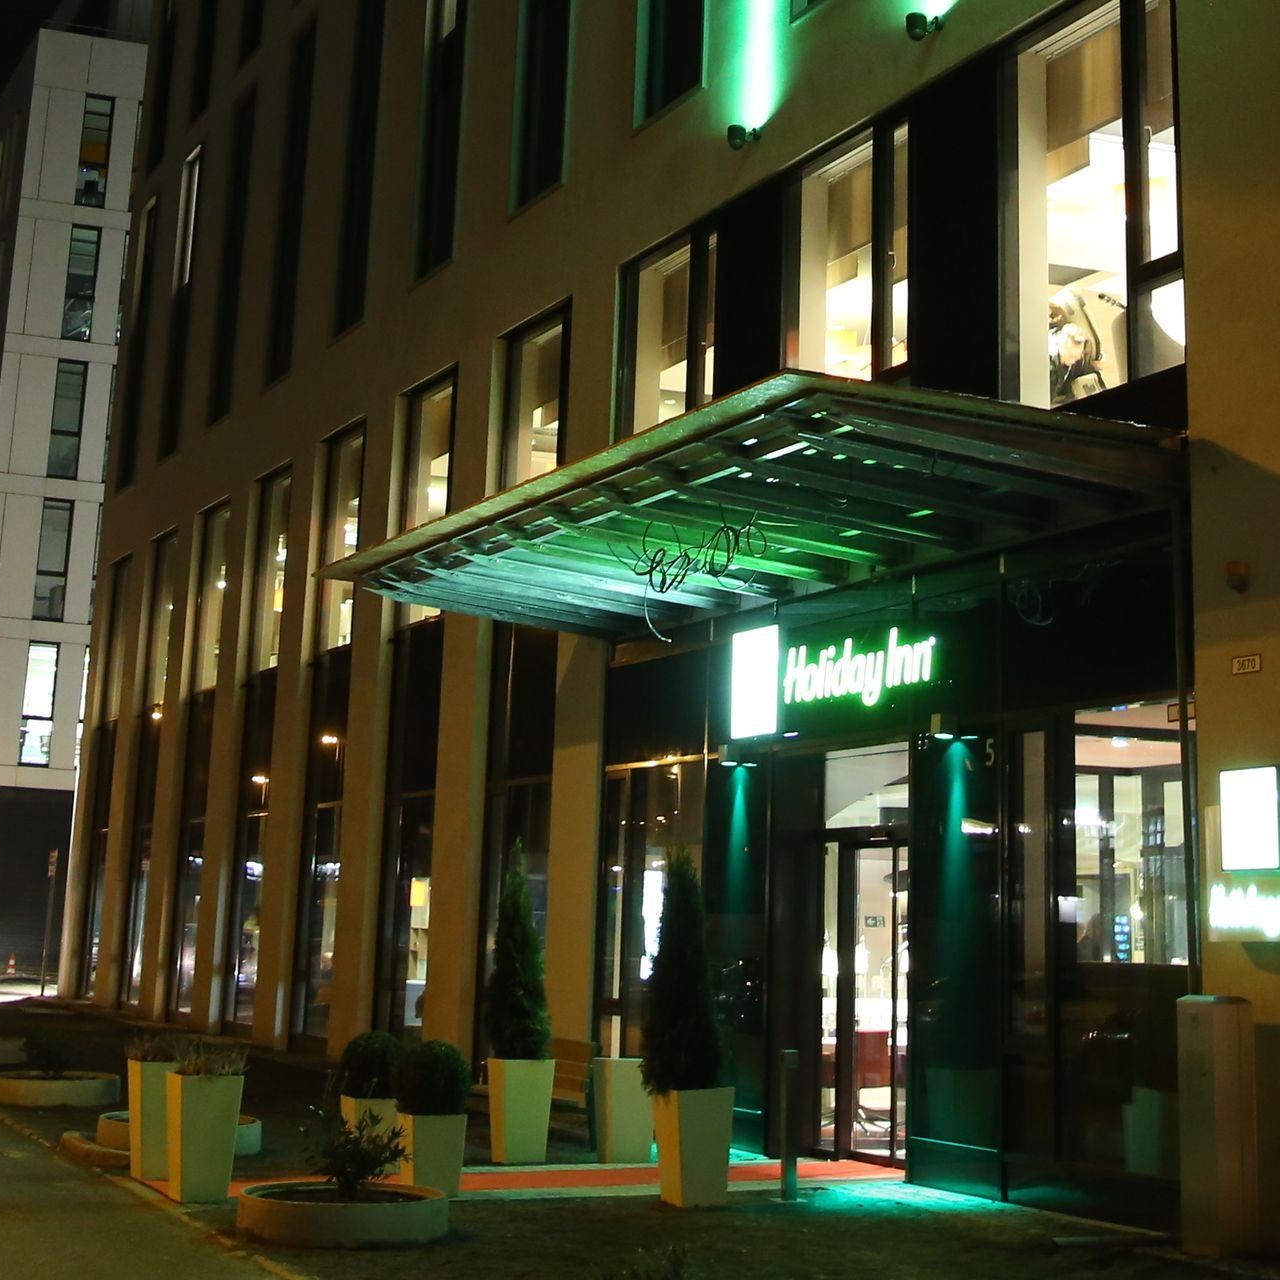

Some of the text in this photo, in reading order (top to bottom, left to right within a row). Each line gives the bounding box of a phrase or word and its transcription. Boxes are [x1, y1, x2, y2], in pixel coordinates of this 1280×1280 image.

[783, 626, 933, 706] Holiday Inn
[986, 738, 995, 767] 5
